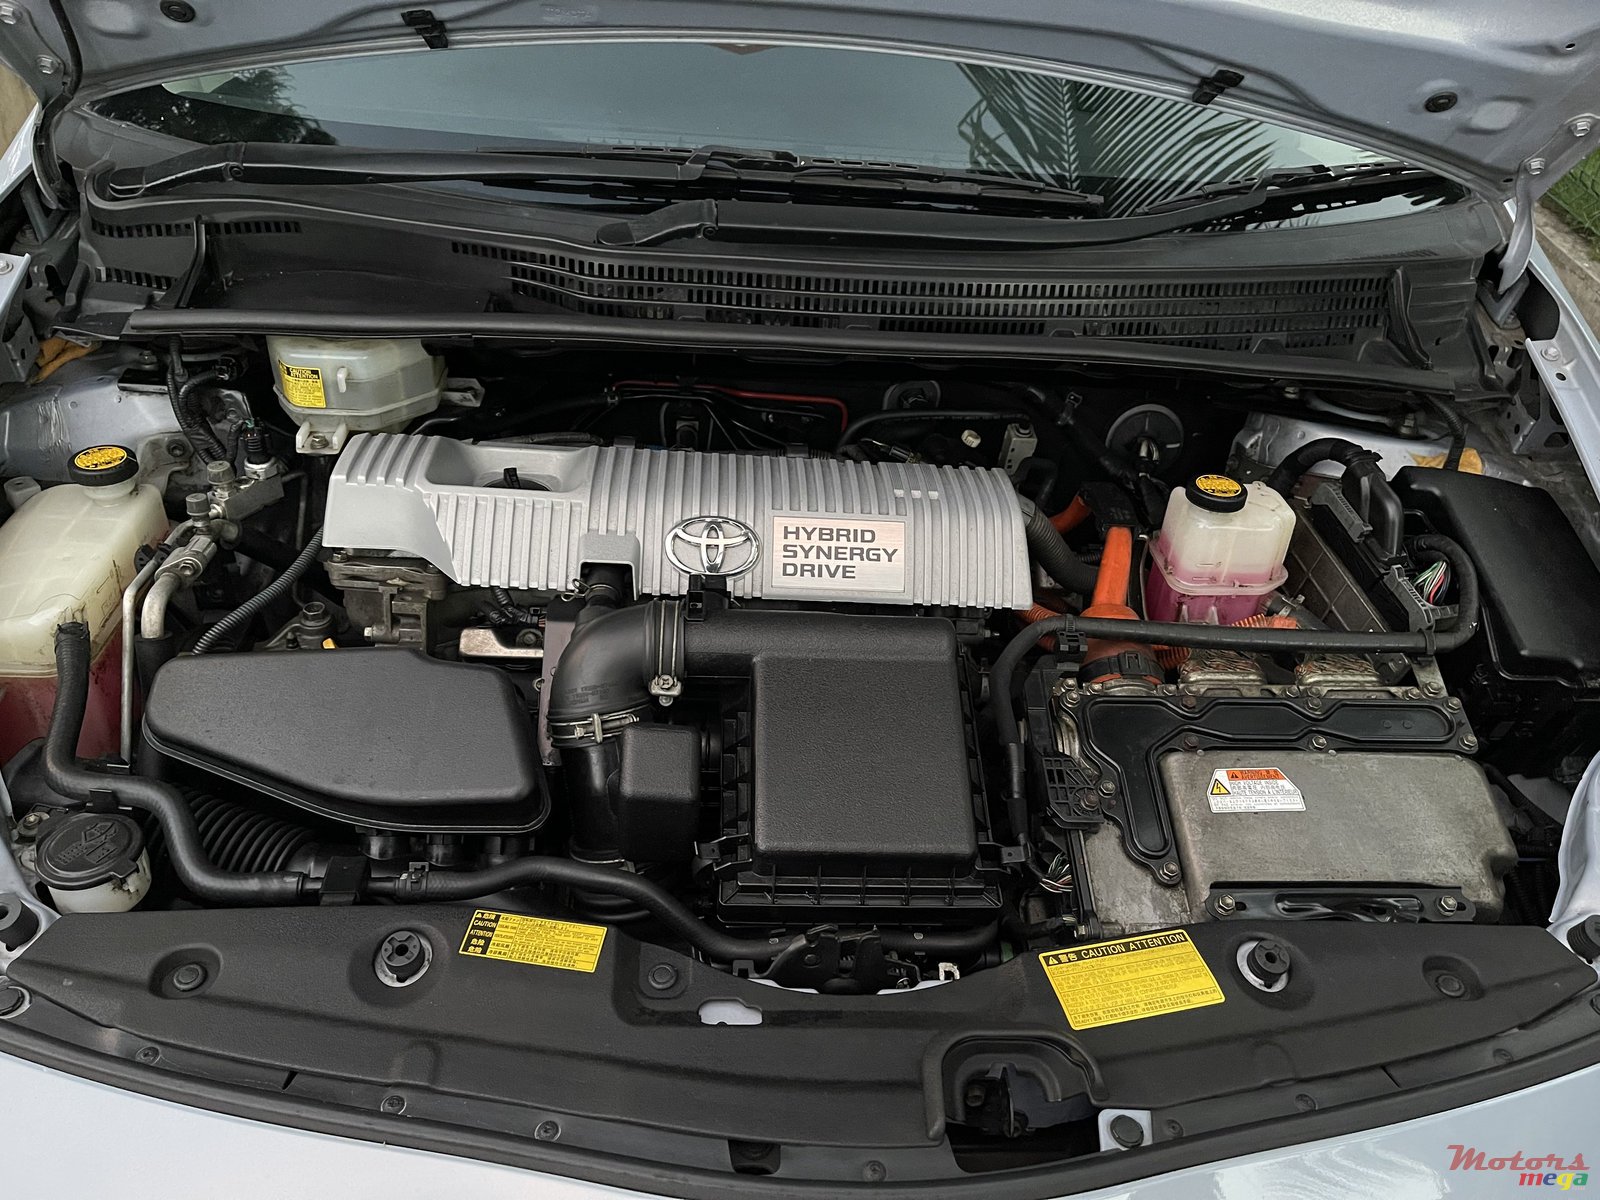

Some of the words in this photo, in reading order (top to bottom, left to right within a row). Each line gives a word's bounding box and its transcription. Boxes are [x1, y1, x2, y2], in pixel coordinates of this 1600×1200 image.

[783, 525, 876, 543] HYBRID
[782, 544, 898, 563] SYNERGY
[782, 562, 856, 579] DRIVE
[473, 919, 498, 928] CAUTION
[469, 929, 494, 938] ATTENTION
[1081, 943, 1126, 959] CAUTION
[1129, 933, 1186, 951] ATTENTION
